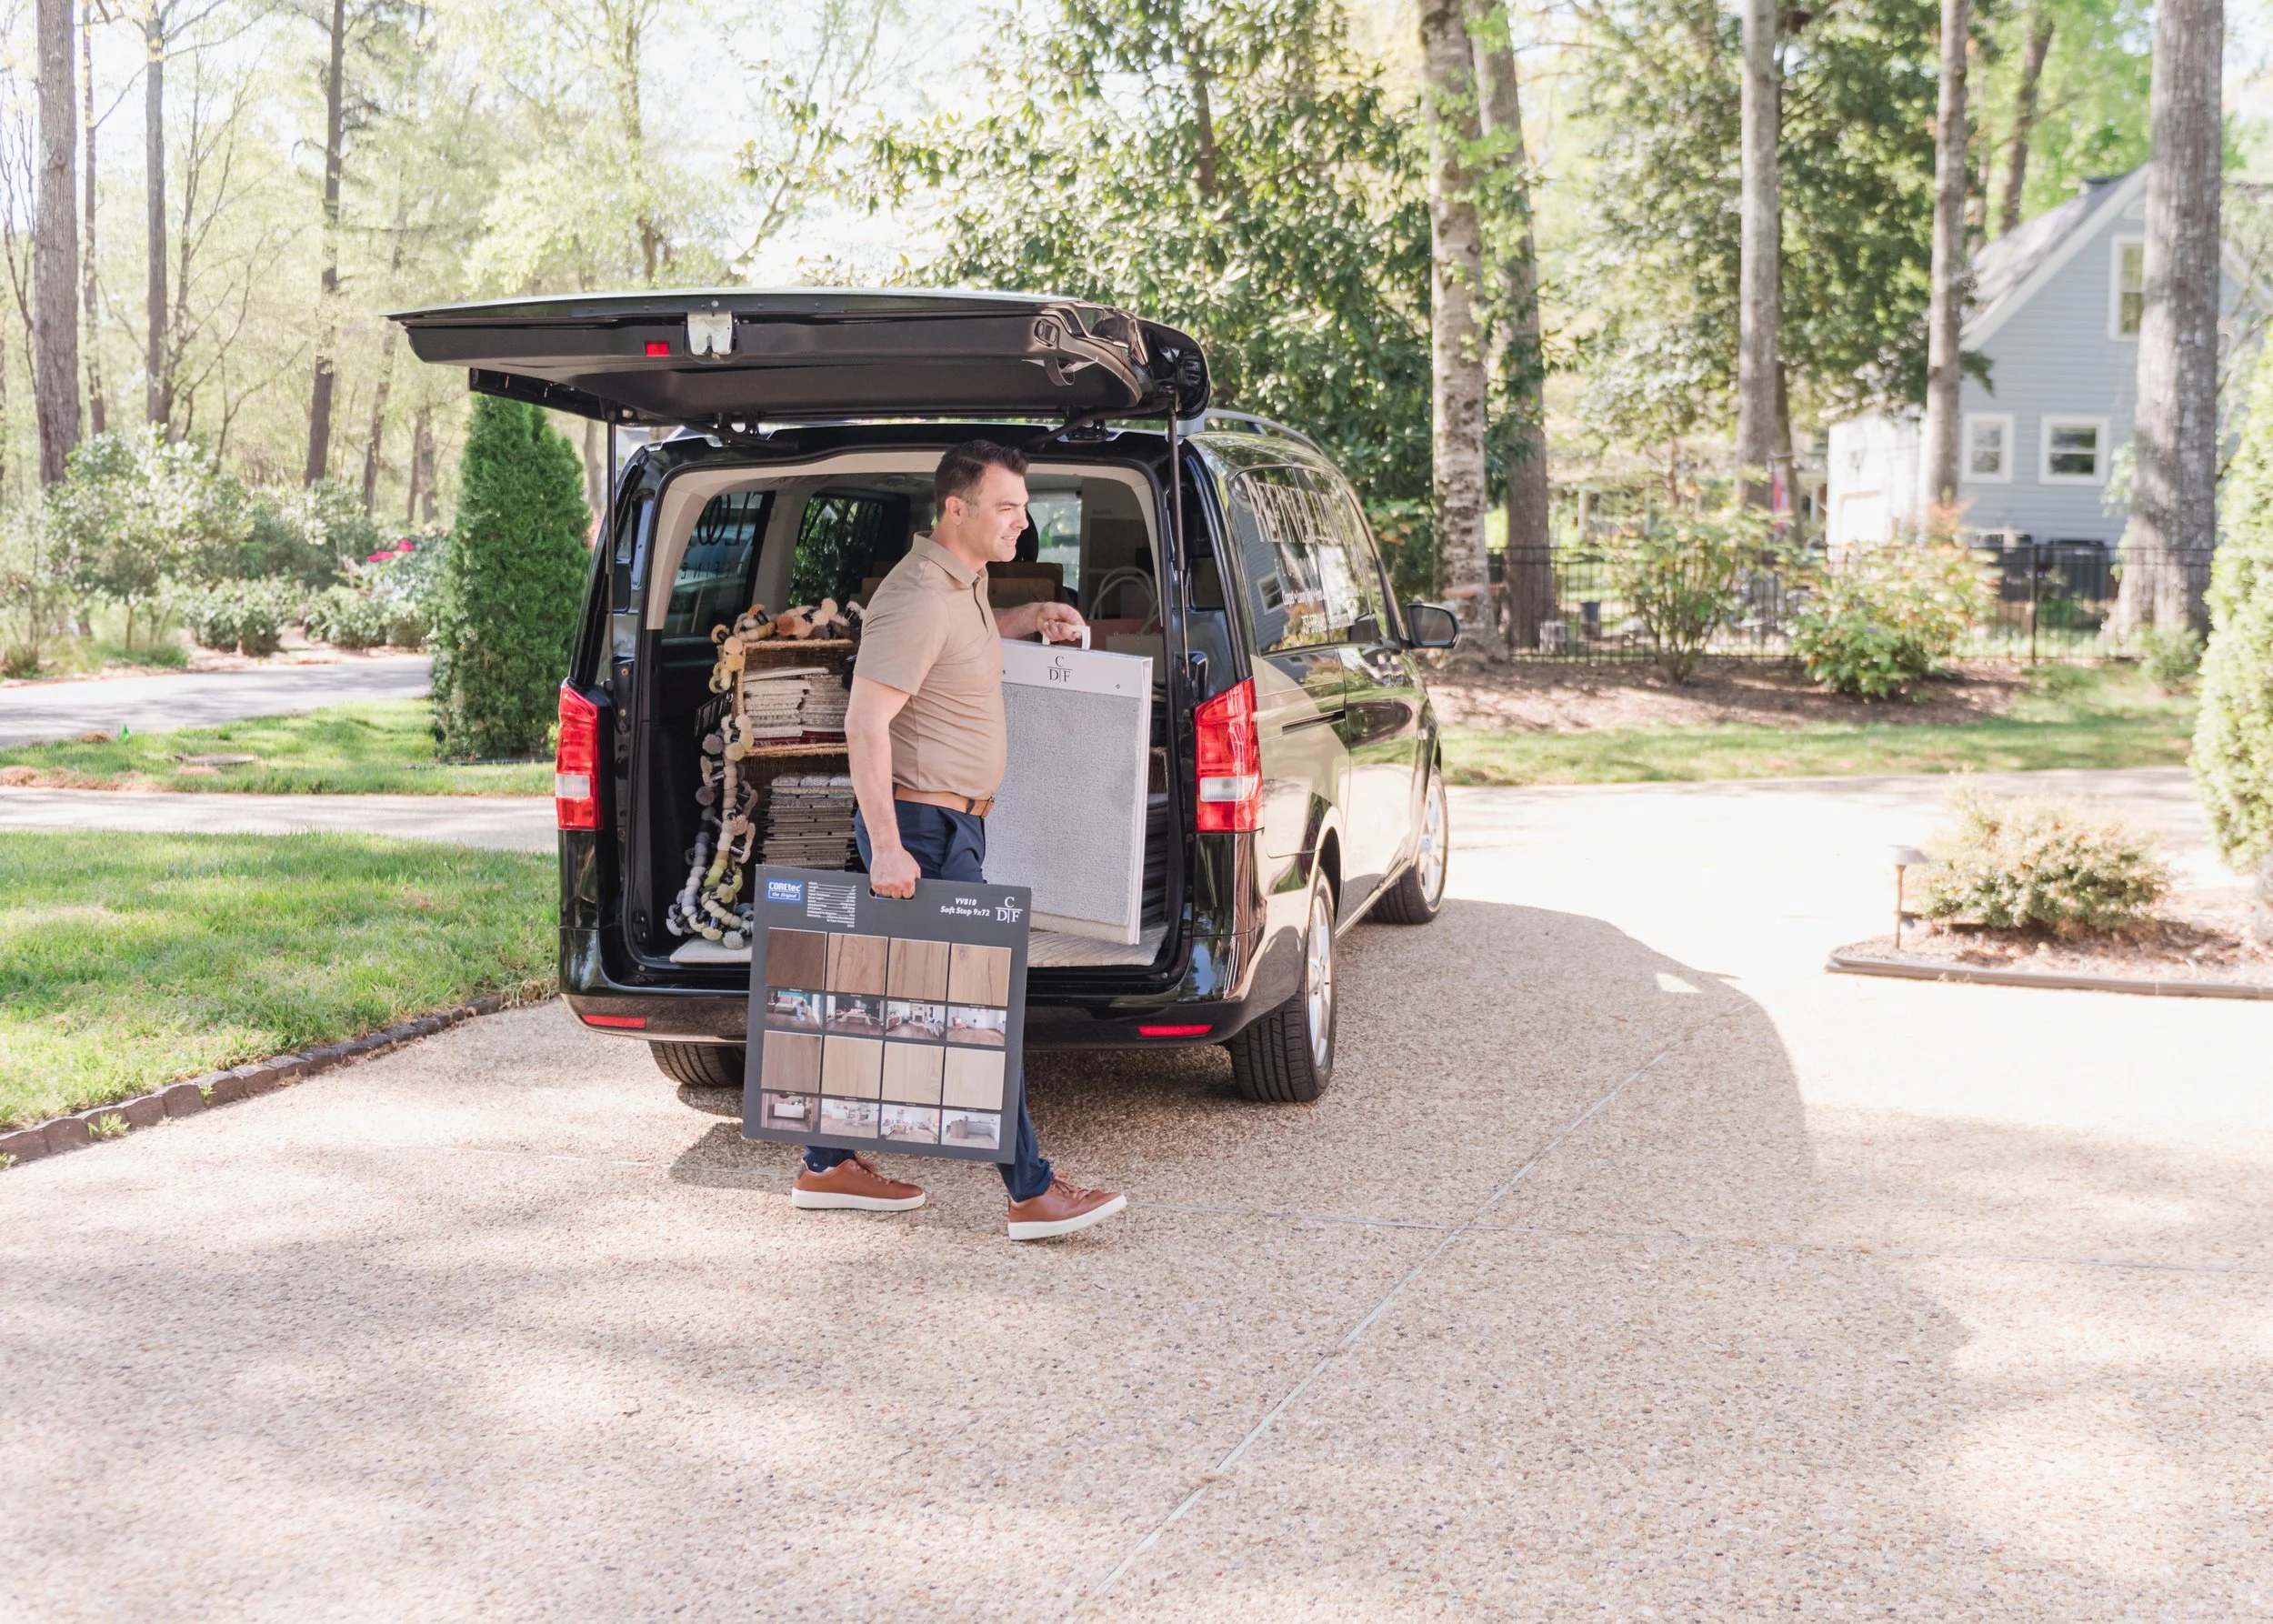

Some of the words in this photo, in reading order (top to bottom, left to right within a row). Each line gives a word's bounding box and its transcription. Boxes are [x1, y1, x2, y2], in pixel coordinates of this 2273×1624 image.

[1055, 655, 1065, 667] C
[1004, 896, 1015, 908] C
[940, 906, 955, 915] Soft
[956, 907, 972, 917] Step
[973, 908, 990, 917] 9x72
